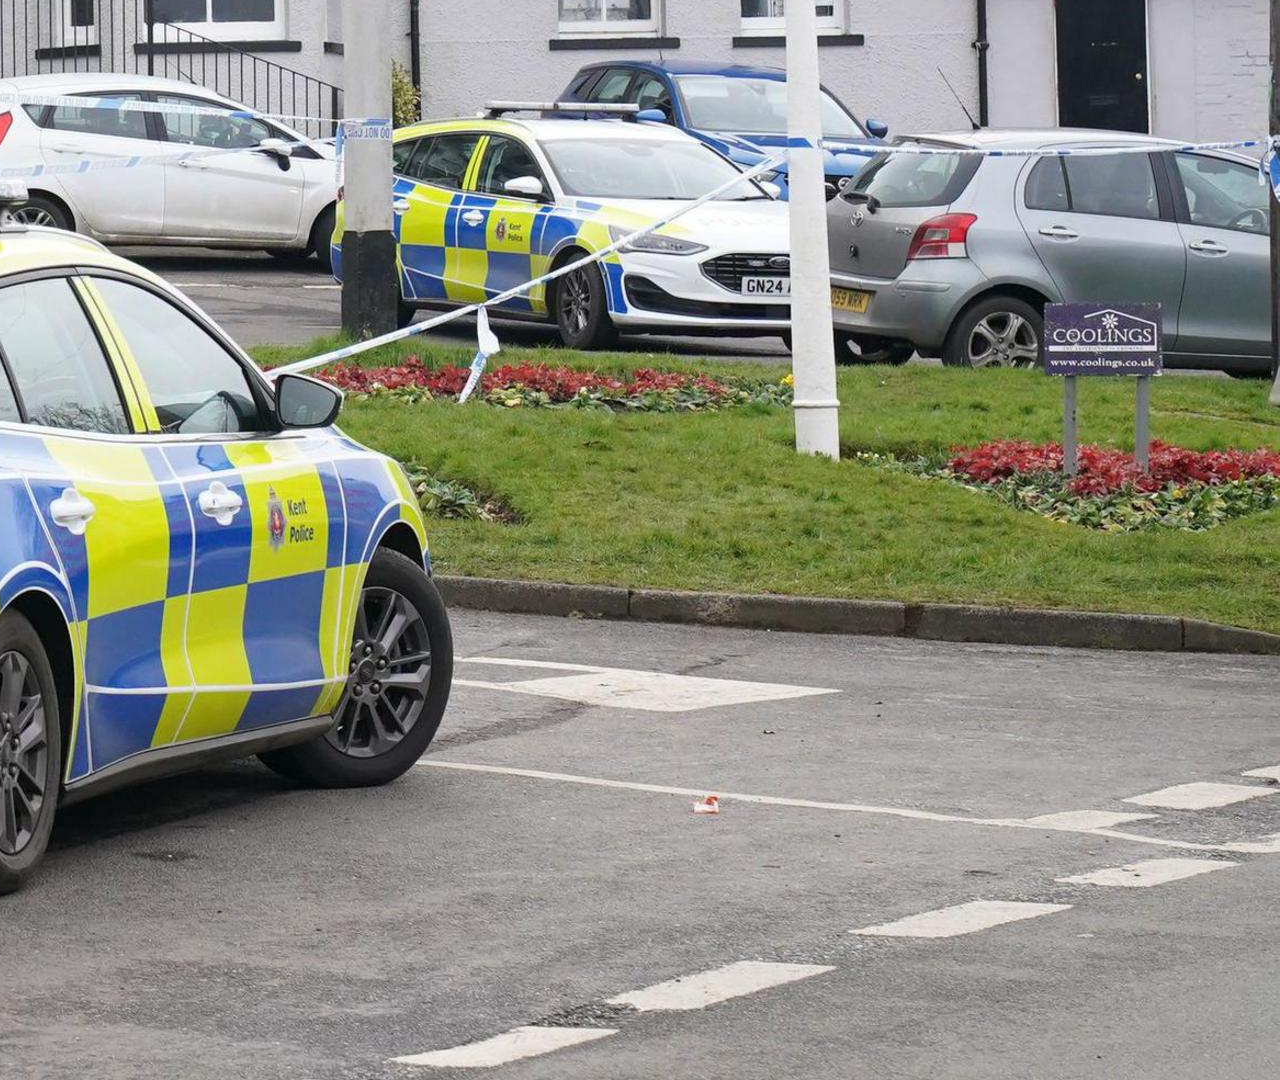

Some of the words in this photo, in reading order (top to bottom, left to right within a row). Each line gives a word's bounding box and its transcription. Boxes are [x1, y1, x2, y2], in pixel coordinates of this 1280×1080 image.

[747, 279, 783, 293] GN24
[1053, 328, 1152, 343] COOLINGS
[1050, 357, 1155, 369] www.coolings.co.uk
[287, 498, 307, 516] Kent
[289, 525, 314, 544] Police
